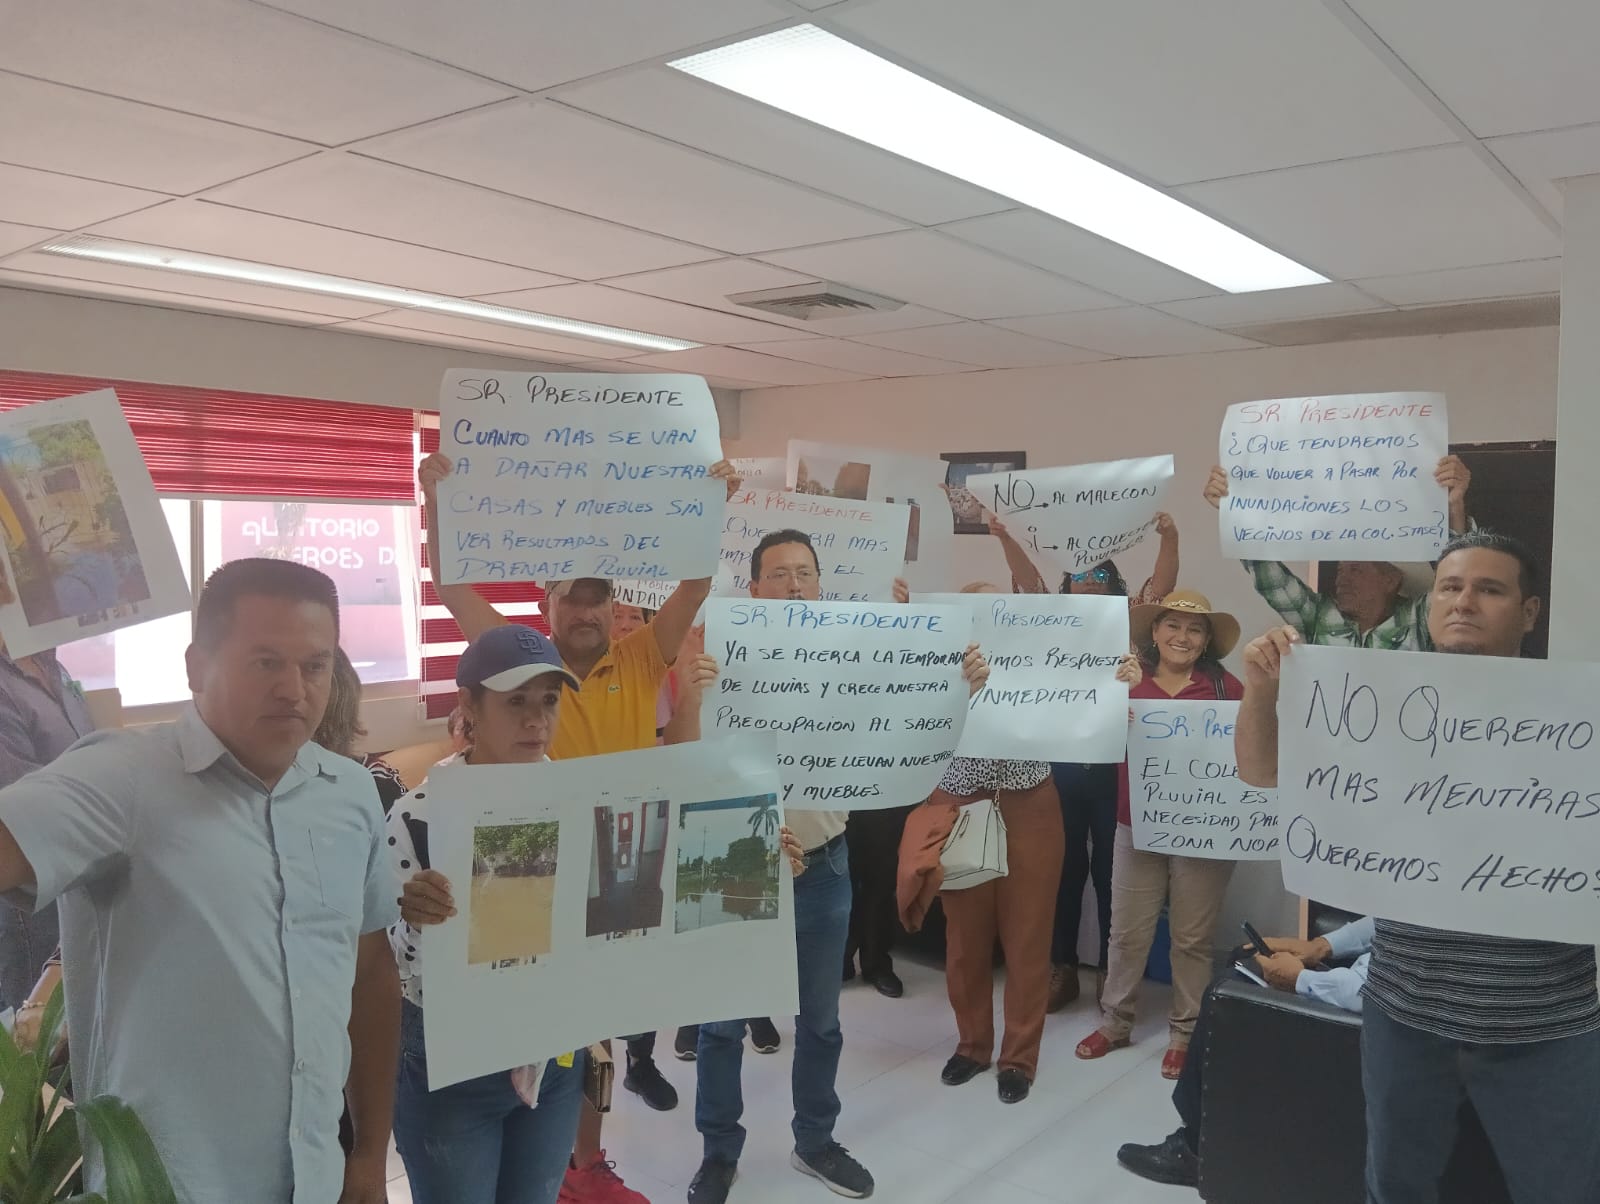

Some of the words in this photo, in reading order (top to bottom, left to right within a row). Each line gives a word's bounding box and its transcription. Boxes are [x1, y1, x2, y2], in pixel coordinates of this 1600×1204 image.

[527, 375, 684, 407] PRESIDENTE
[1240, 404, 1281, 424] SR
[1300, 399, 1433, 424] PRESIDENTE
[454, 419, 530, 446] CUANTO
[544, 427, 596, 446] MAS
[607, 430, 642, 445] SE
[651, 429, 697, 446] VAN
[1298, 433, 1420, 452] TENDREMOS
[455, 457, 471, 476] A
[495, 456, 588, 479] DAÑAR
[604, 461, 712, 481] NUESTRA
[1231, 465, 1260, 480] QUE
[1266, 466, 1314, 482] VOLVER
[1340, 460, 1380, 480] PASAR
[1392, 460, 1418, 479] POR
[450, 491, 543, 517] CASAS
[555, 498, 566, 518] Y
[574, 498, 654, 515] MUEBLES
[665, 497, 704, 517] SIN
[994, 473, 1035, 513] NO
[1052, 490, 1067, 504] AL
[1075, 485, 1157, 505] MALECON
[1229, 495, 1351, 515] INUNDACIONES
[1359, 499, 1408, 513] LOS
[765, 492, 873, 522] PRESIDENTE
[456, 530, 491, 551] VER
[503, 529, 609, 550] RESULTADOS
[623, 534, 661, 551] DEL
[848, 535, 888, 552] MAS
[1066, 536, 1081, 551] AL
[1233, 525, 1304, 543] VECINOS
[1311, 529, 1334, 542] DE
[1339, 528, 1357, 541] LA
[456, 557, 574, 580] DRENAJE
[593, 554, 669, 578] PLUVIAL
[834, 564, 864, 575] EL
[783, 602, 943, 632] PRESIDENTE
[992, 599, 1084, 628] PRESIDENTE
[725, 640, 748, 666] YA
[758, 650, 784, 660] SE
[793, 648, 860, 664] ACERCA
[873, 650, 893, 664] LA
[721, 678, 742, 693] DE
[752, 677, 810, 694] LLUVIAS
[821, 682, 830, 698] Y
[837, 682, 881, 695] CRECE
[886, 680, 949, 695] NUESTRA
[970, 684, 1097, 710] INMEDIATA
[716, 705, 855, 732] PREOCUPACION
[869, 717, 892, 732] AL
[904, 717, 953, 731] SABER
[1202, 708, 1234, 738] PRE
[1306, 672, 1378, 743] NO
[1399, 685, 1593, 758] QUEREMO
[800, 755, 836, 772] QUE
[842, 754, 895, 769] LLEVAN
[1140, 757, 1177, 780] EL
[783, 783, 794, 800] Y
[1144, 781, 1227, 805] PLUVIAL
[1240, 790, 1268, 804] ES
[1306, 764, 1378, 804] MAS
[1404, 774, 1600, 820] MENTIRAS
[1142, 810, 1241, 832] NECESIDAD
[1147, 832, 1214, 850] ZONA
[1286, 814, 1441, 883] QUEREMOS
